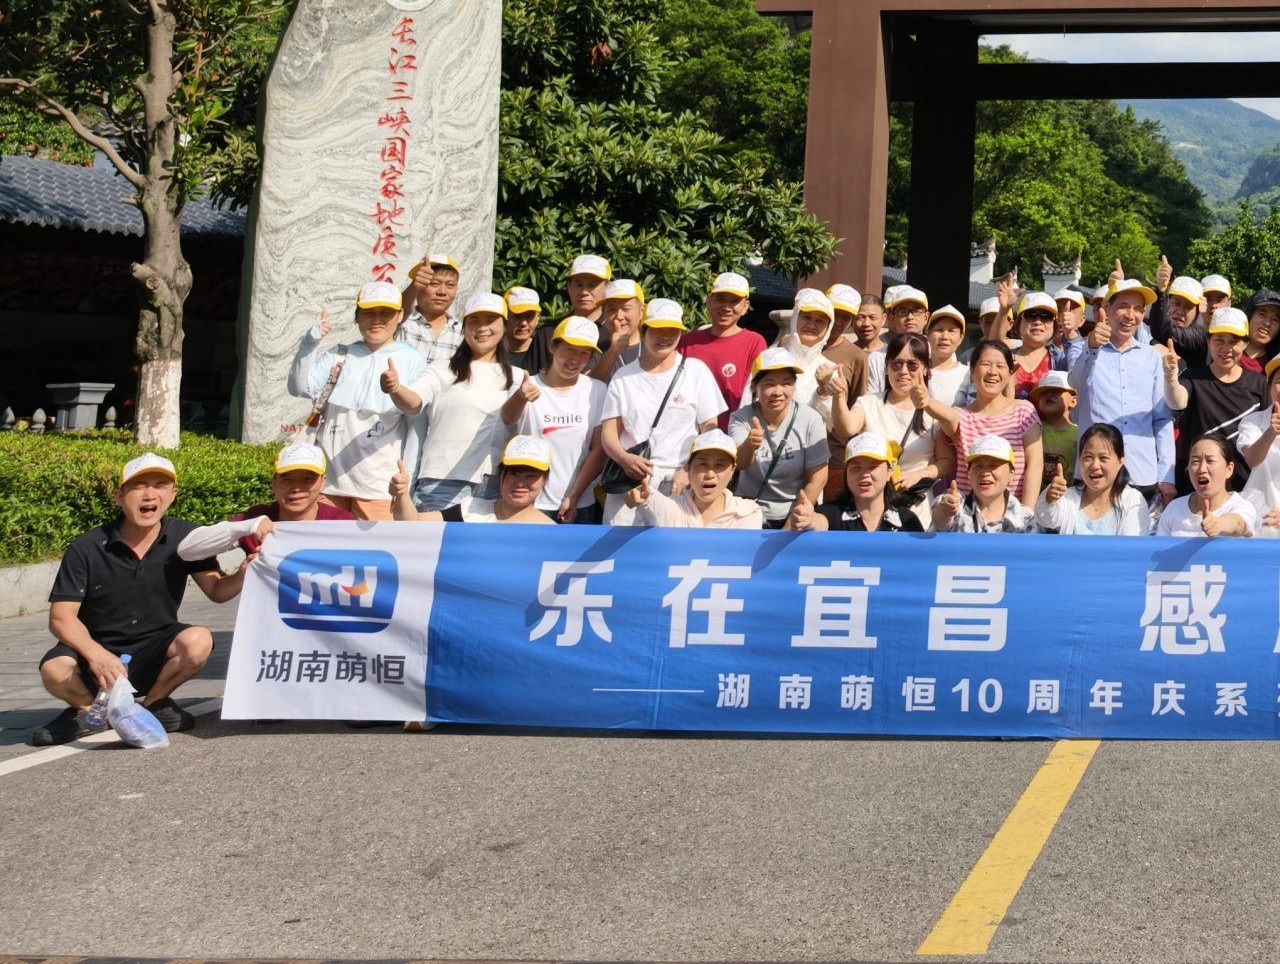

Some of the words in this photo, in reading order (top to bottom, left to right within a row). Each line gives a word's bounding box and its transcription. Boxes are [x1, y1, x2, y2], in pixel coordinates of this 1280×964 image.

[529, 558, 1008, 652] 乐在宜昌
[256, 649, 406, 686] 湖南萌恒
